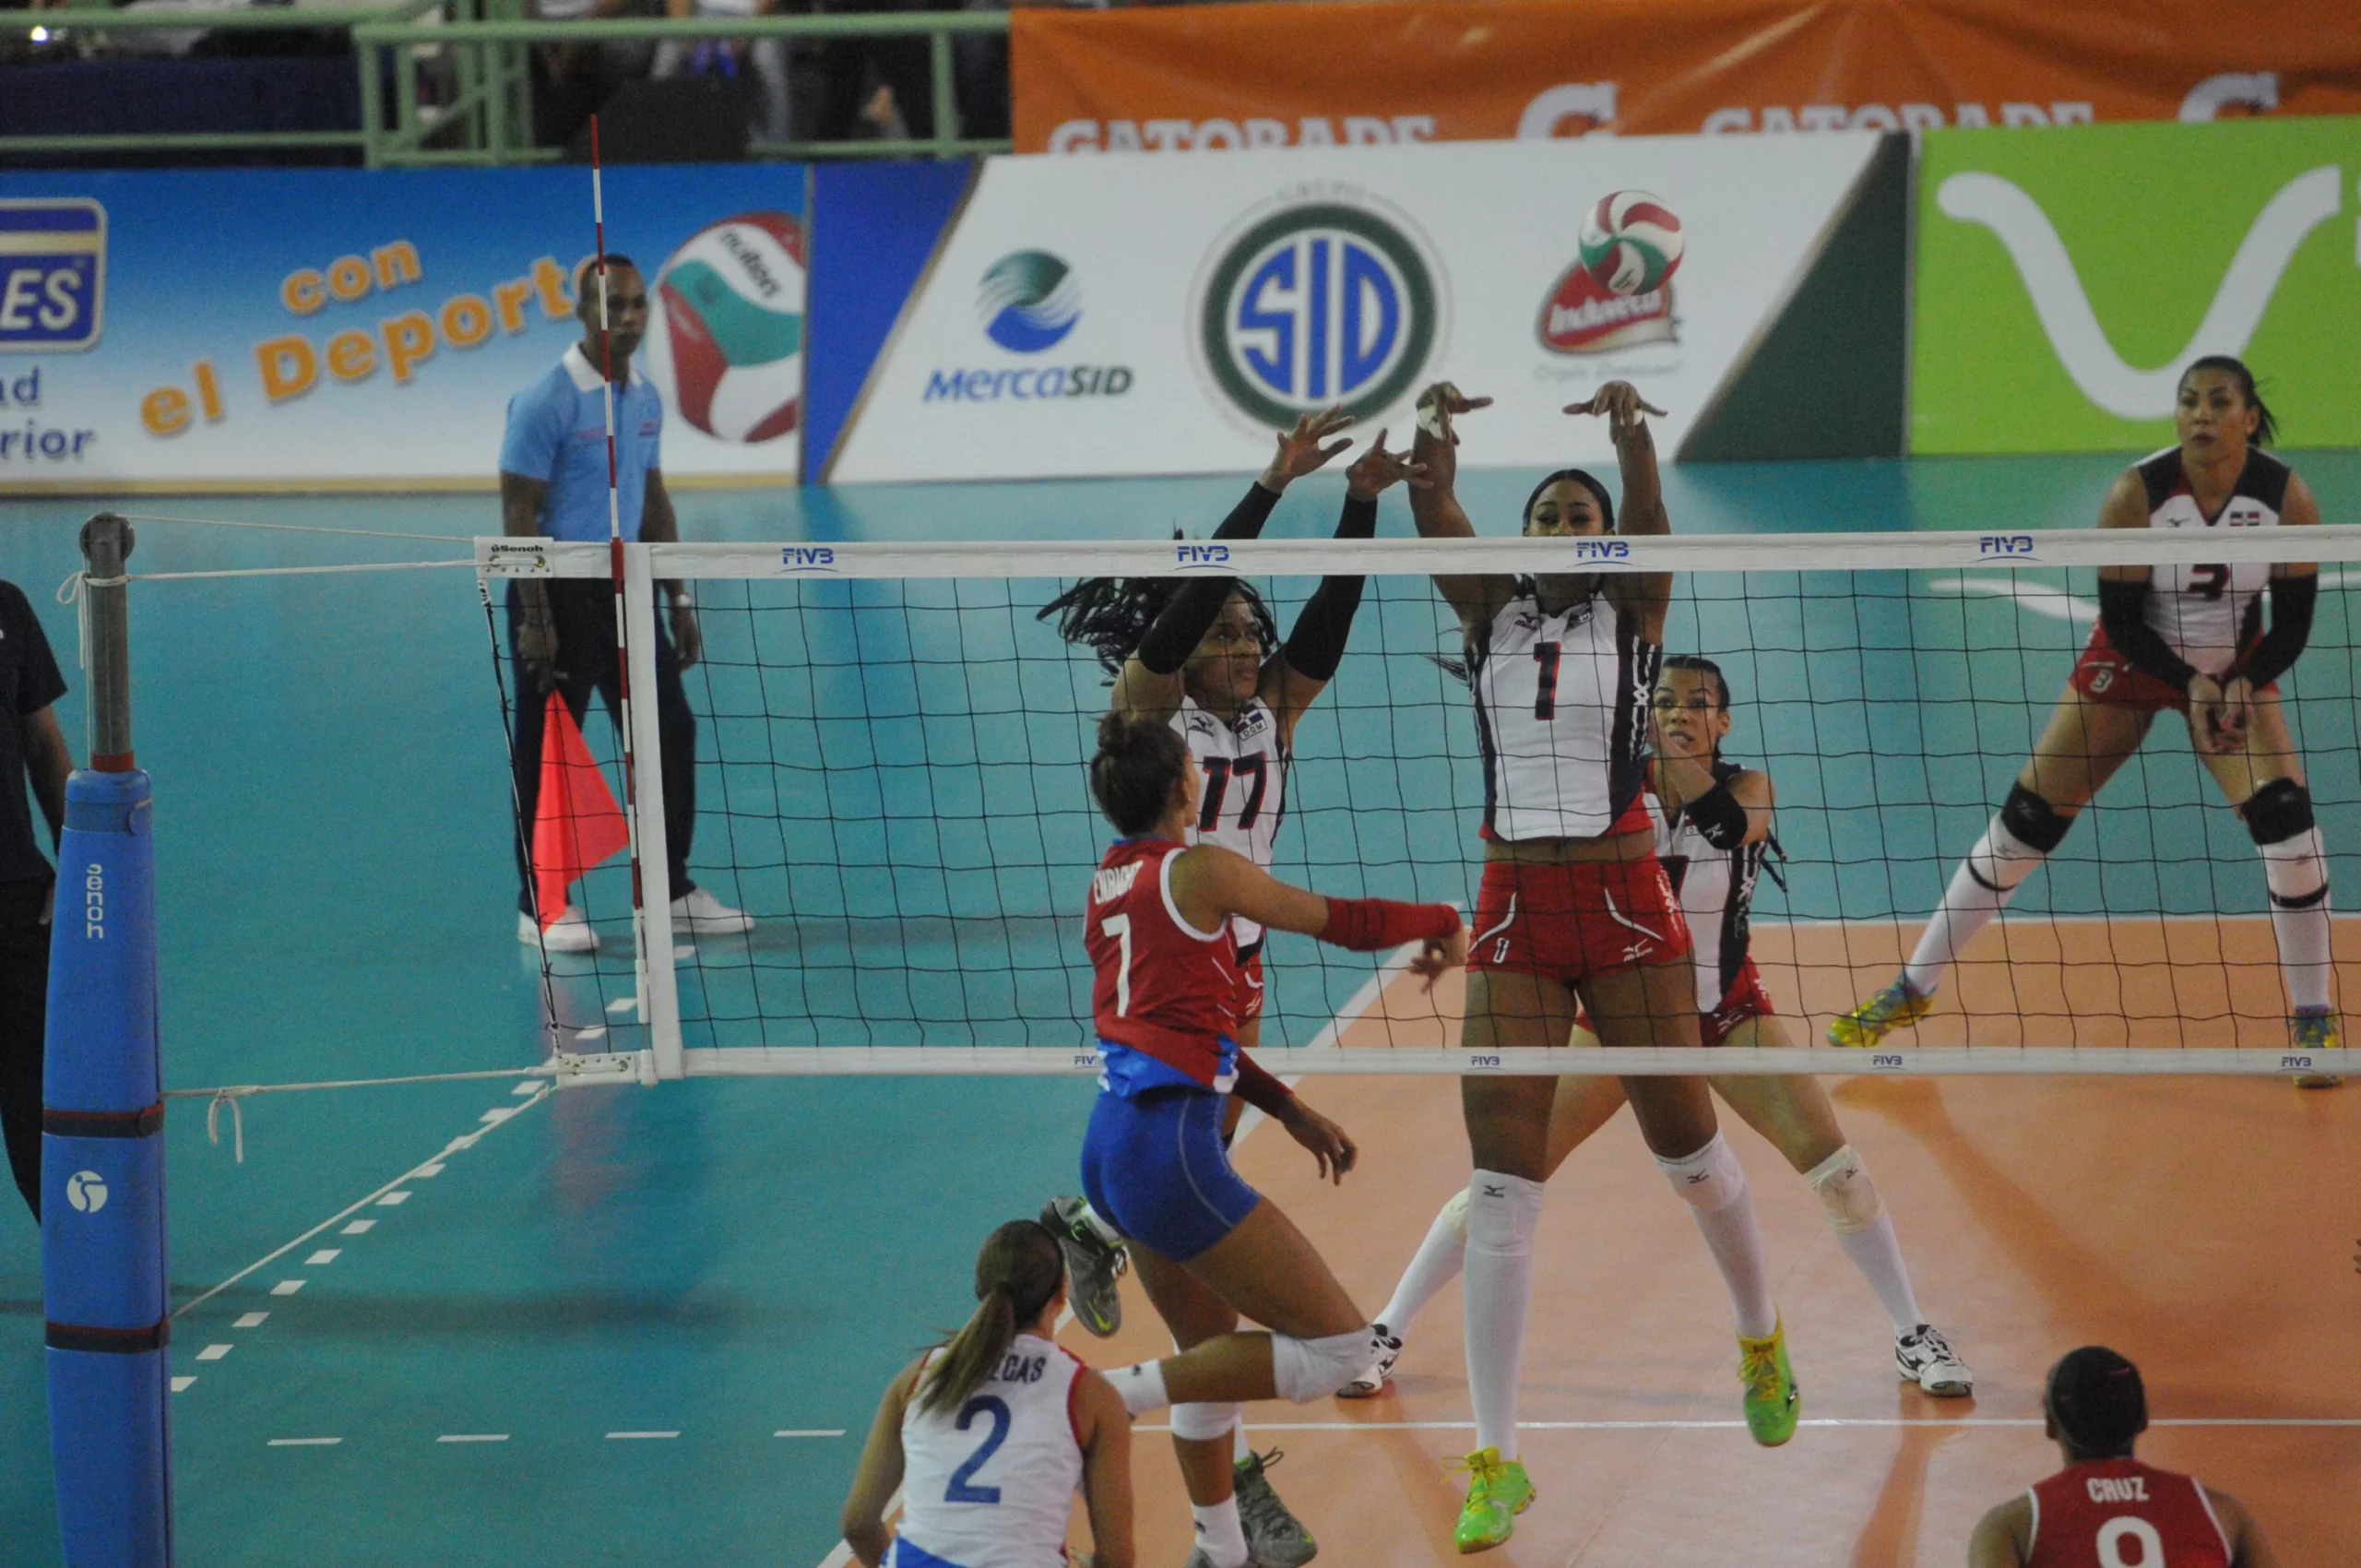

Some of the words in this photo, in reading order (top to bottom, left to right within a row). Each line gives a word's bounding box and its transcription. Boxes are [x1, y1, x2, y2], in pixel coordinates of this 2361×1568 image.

[279, 238, 422, 316] con
[1238, 238, 1401, 400] SID
[140, 358, 223, 436] el
[255, 253, 598, 403] Deport
[0, 365, 42, 408] d
[782, 548, 835, 564] FIVB
[1177, 545, 1230, 562] FIVB
[1576, 540, 1630, 558] FIVB
[1980, 535, 2034, 552] FIVB
[1534, 641, 1562, 721] 1
[1199, 750, 1267, 833] 17
[1492, 936, 1511, 964] 1
[1101, 912, 1132, 1018] 7
[1074, 1055, 1097, 1065] FIV
[1471, 1054, 1501, 1066] FIVB
[1872, 1054, 1903, 1065] FIVB
[2282, 1056, 2312, 1067] FIVB
[990, 1353, 1049, 1384] GAS
[943, 1394, 1013, 1504] 2
[2086, 1476, 2152, 1504] CRUZ
